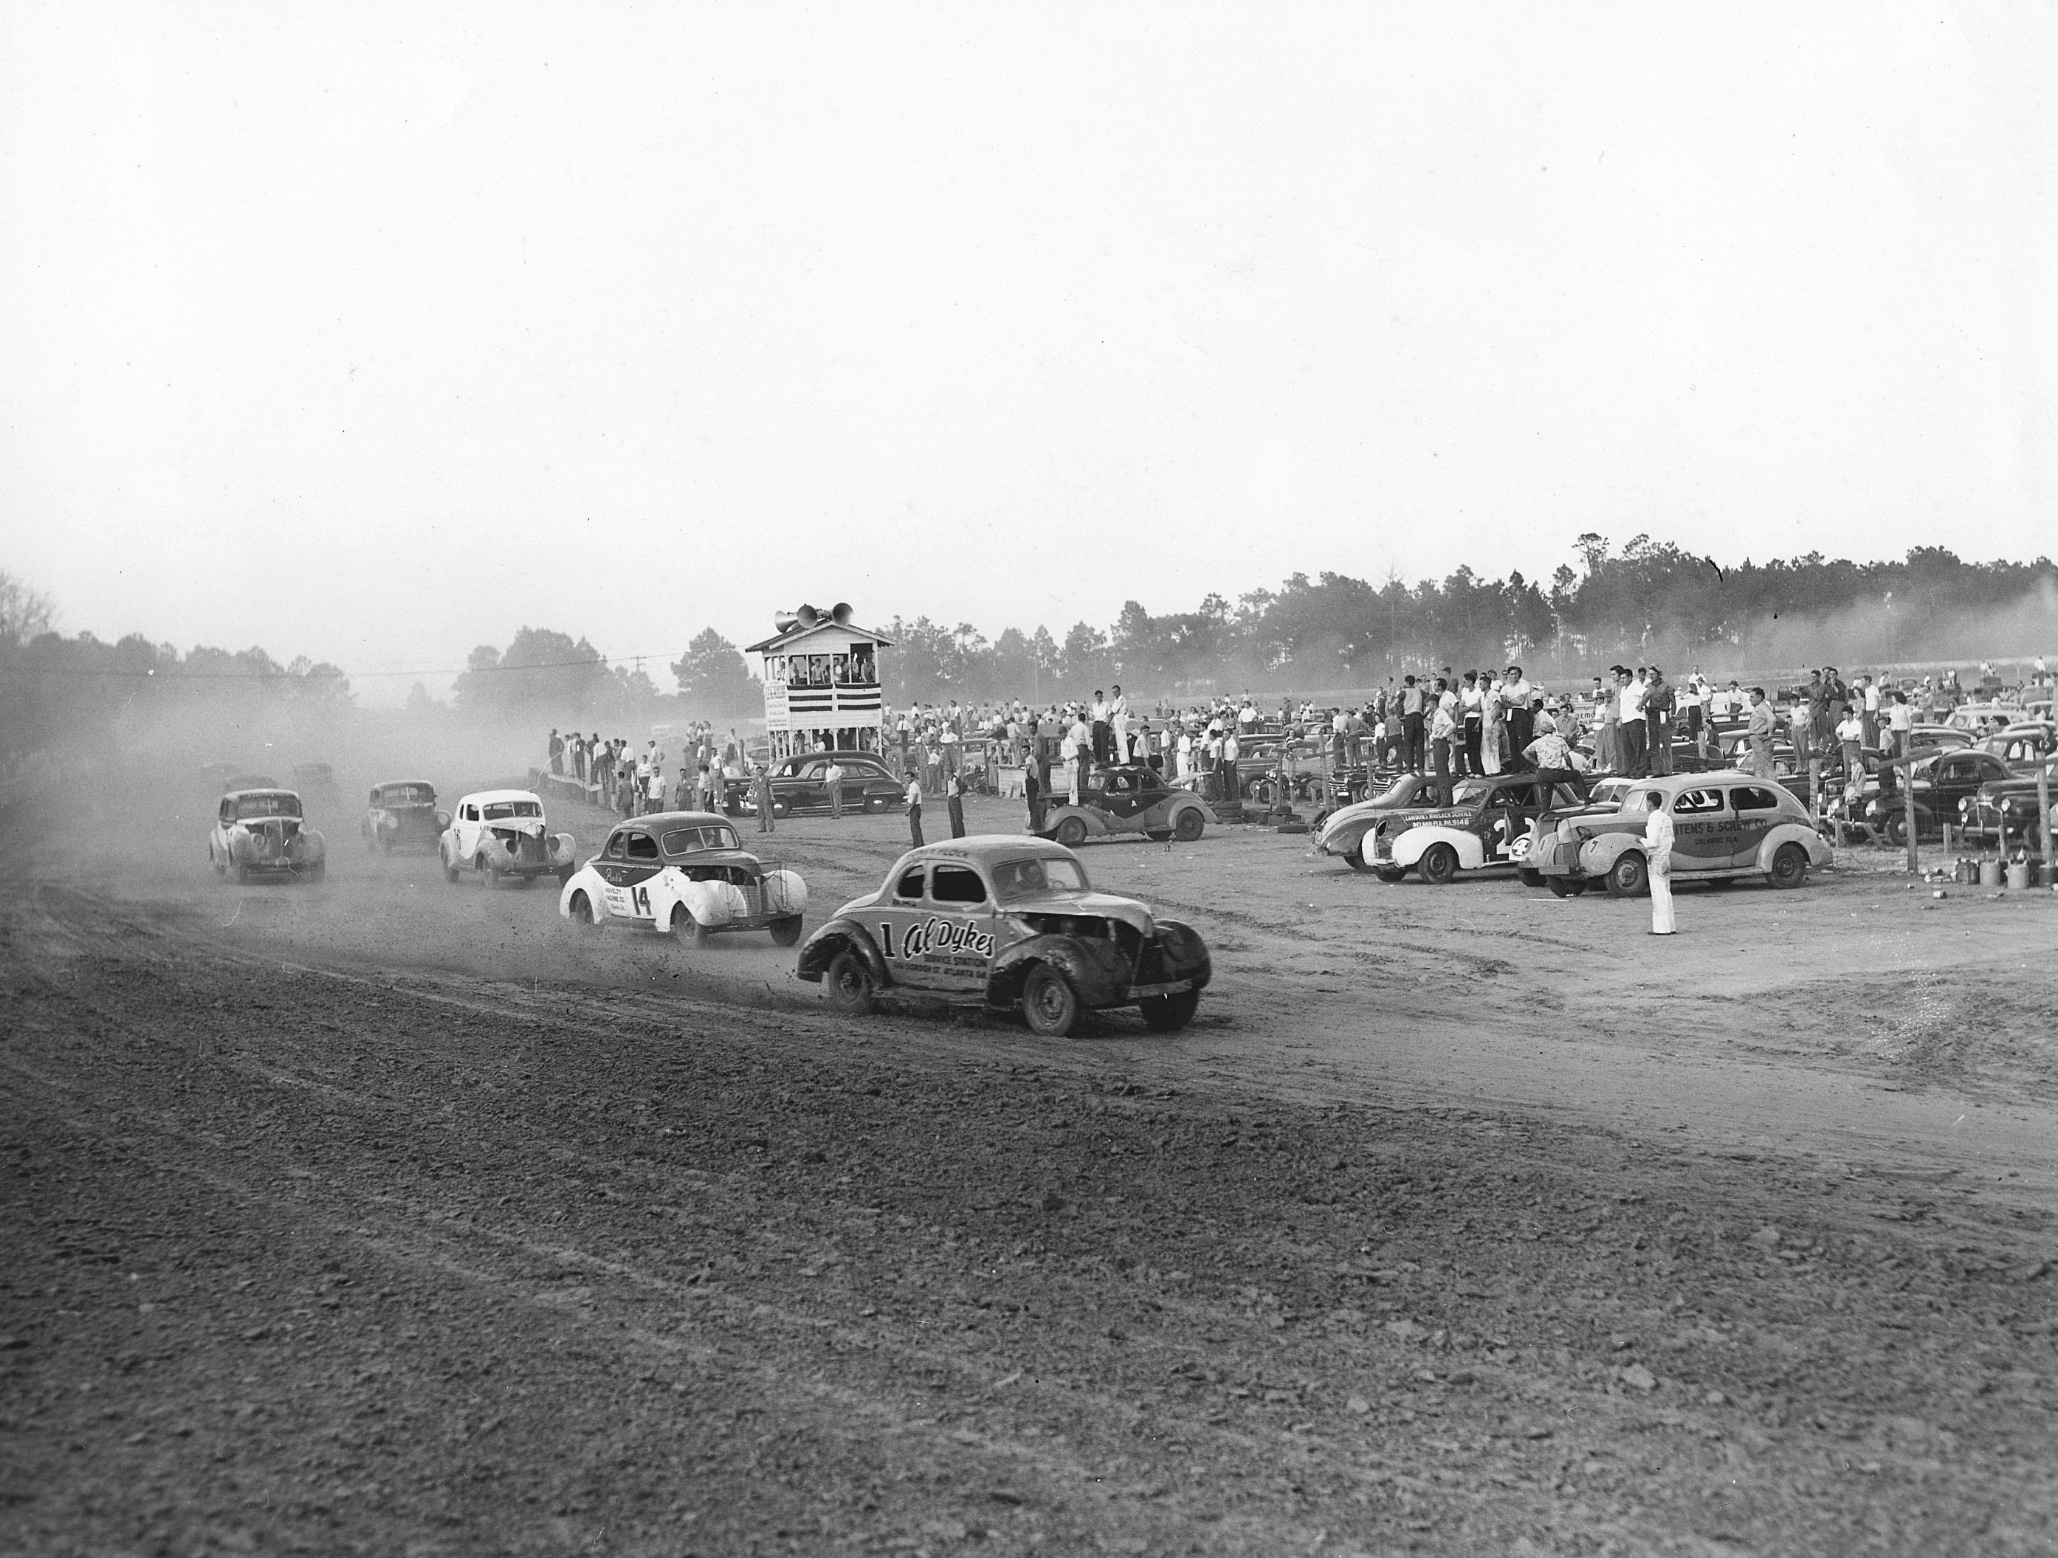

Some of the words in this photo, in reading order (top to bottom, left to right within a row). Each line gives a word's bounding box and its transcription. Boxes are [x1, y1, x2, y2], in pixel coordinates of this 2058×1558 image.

[1706, 822, 1715, 833] &
[1717, 819, 1750, 832] SCREW
[1590, 840, 1599, 853] 7
[631, 886, 652, 916] 14
[880, 922, 897, 959] 1
[902, 916, 937, 960] Al
[936, 920, 995, 959] Dykes
[953, 956, 988, 968] STATION
[943, 967, 974, 977] ATLANTA
